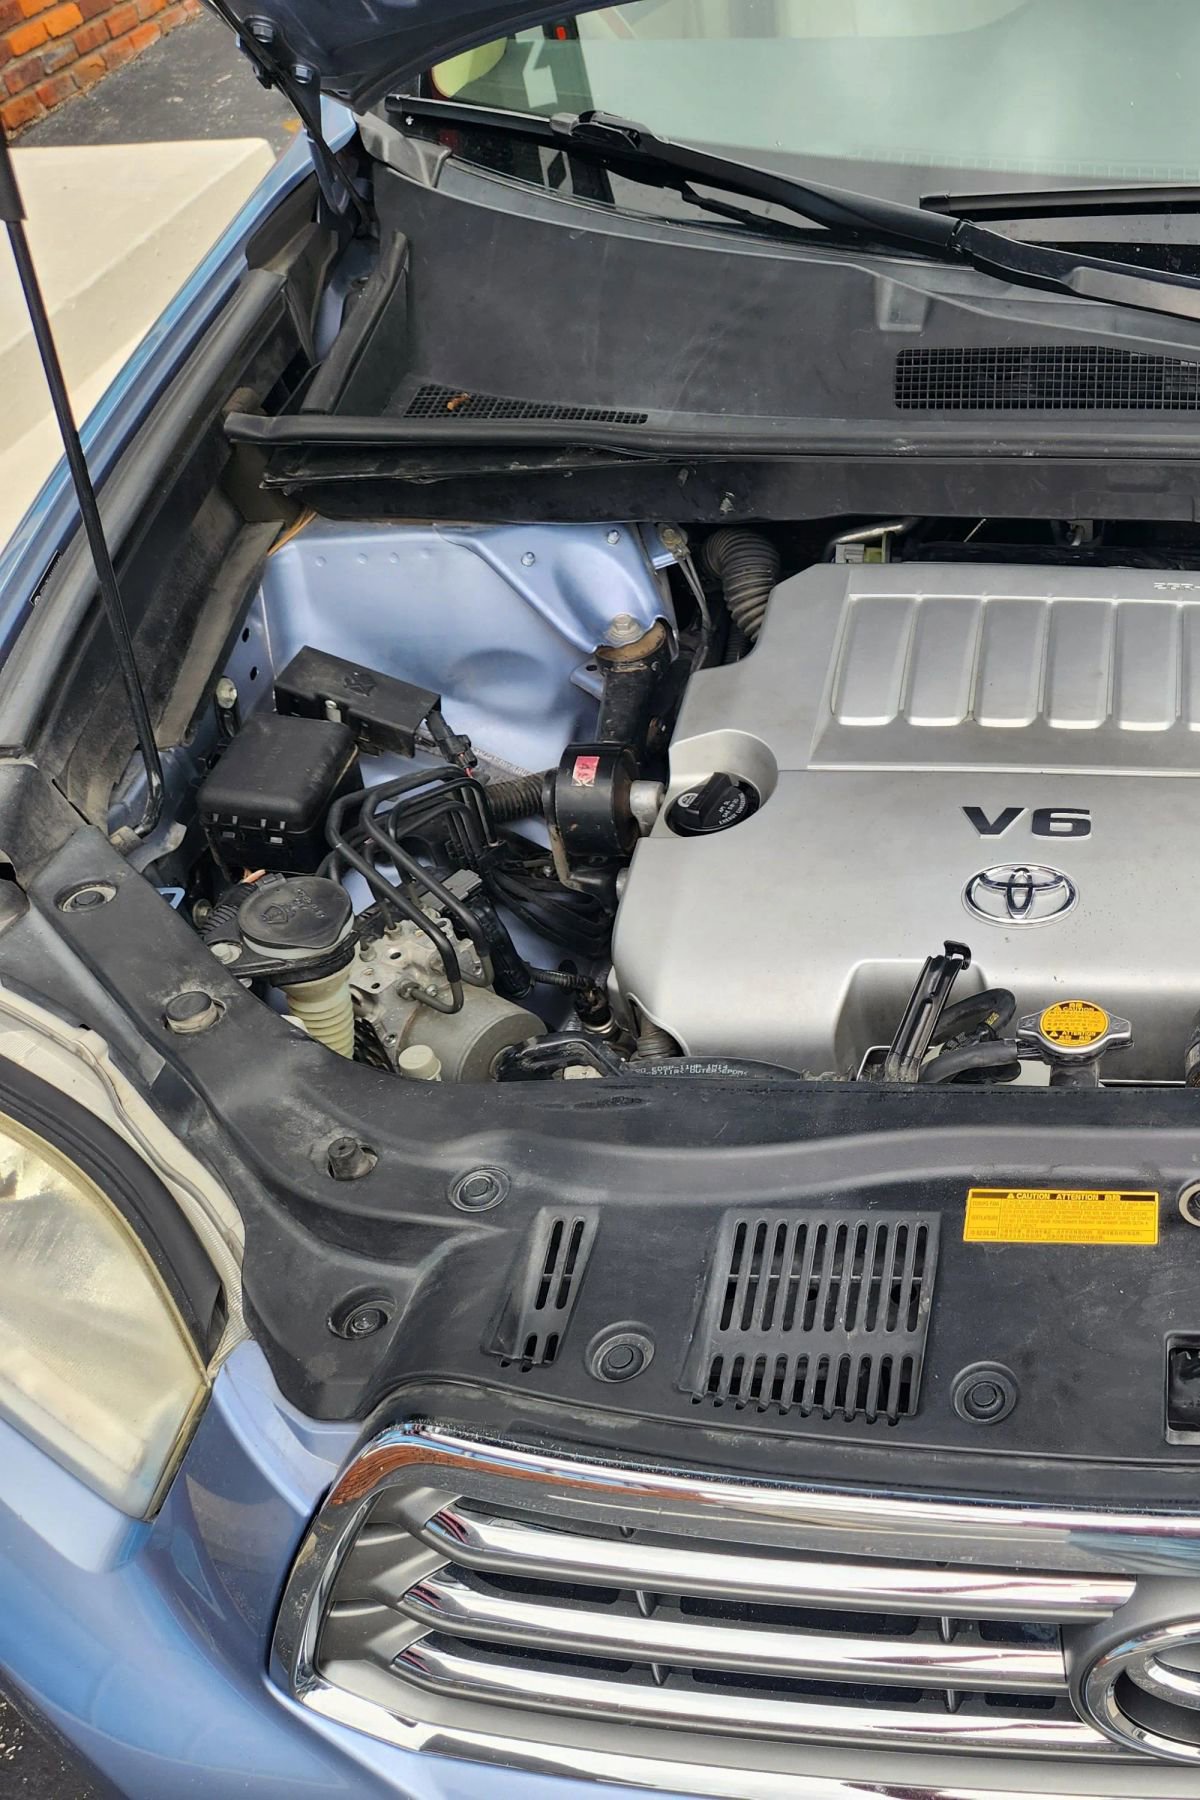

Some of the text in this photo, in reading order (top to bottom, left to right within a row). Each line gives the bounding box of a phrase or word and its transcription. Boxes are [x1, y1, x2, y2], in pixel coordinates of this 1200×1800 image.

[961, 806, 1092, 840] V6
[1016, 1192, 1051, 1200] CAUTION
[1056, 1193, 1099, 1201] ATTENTION
